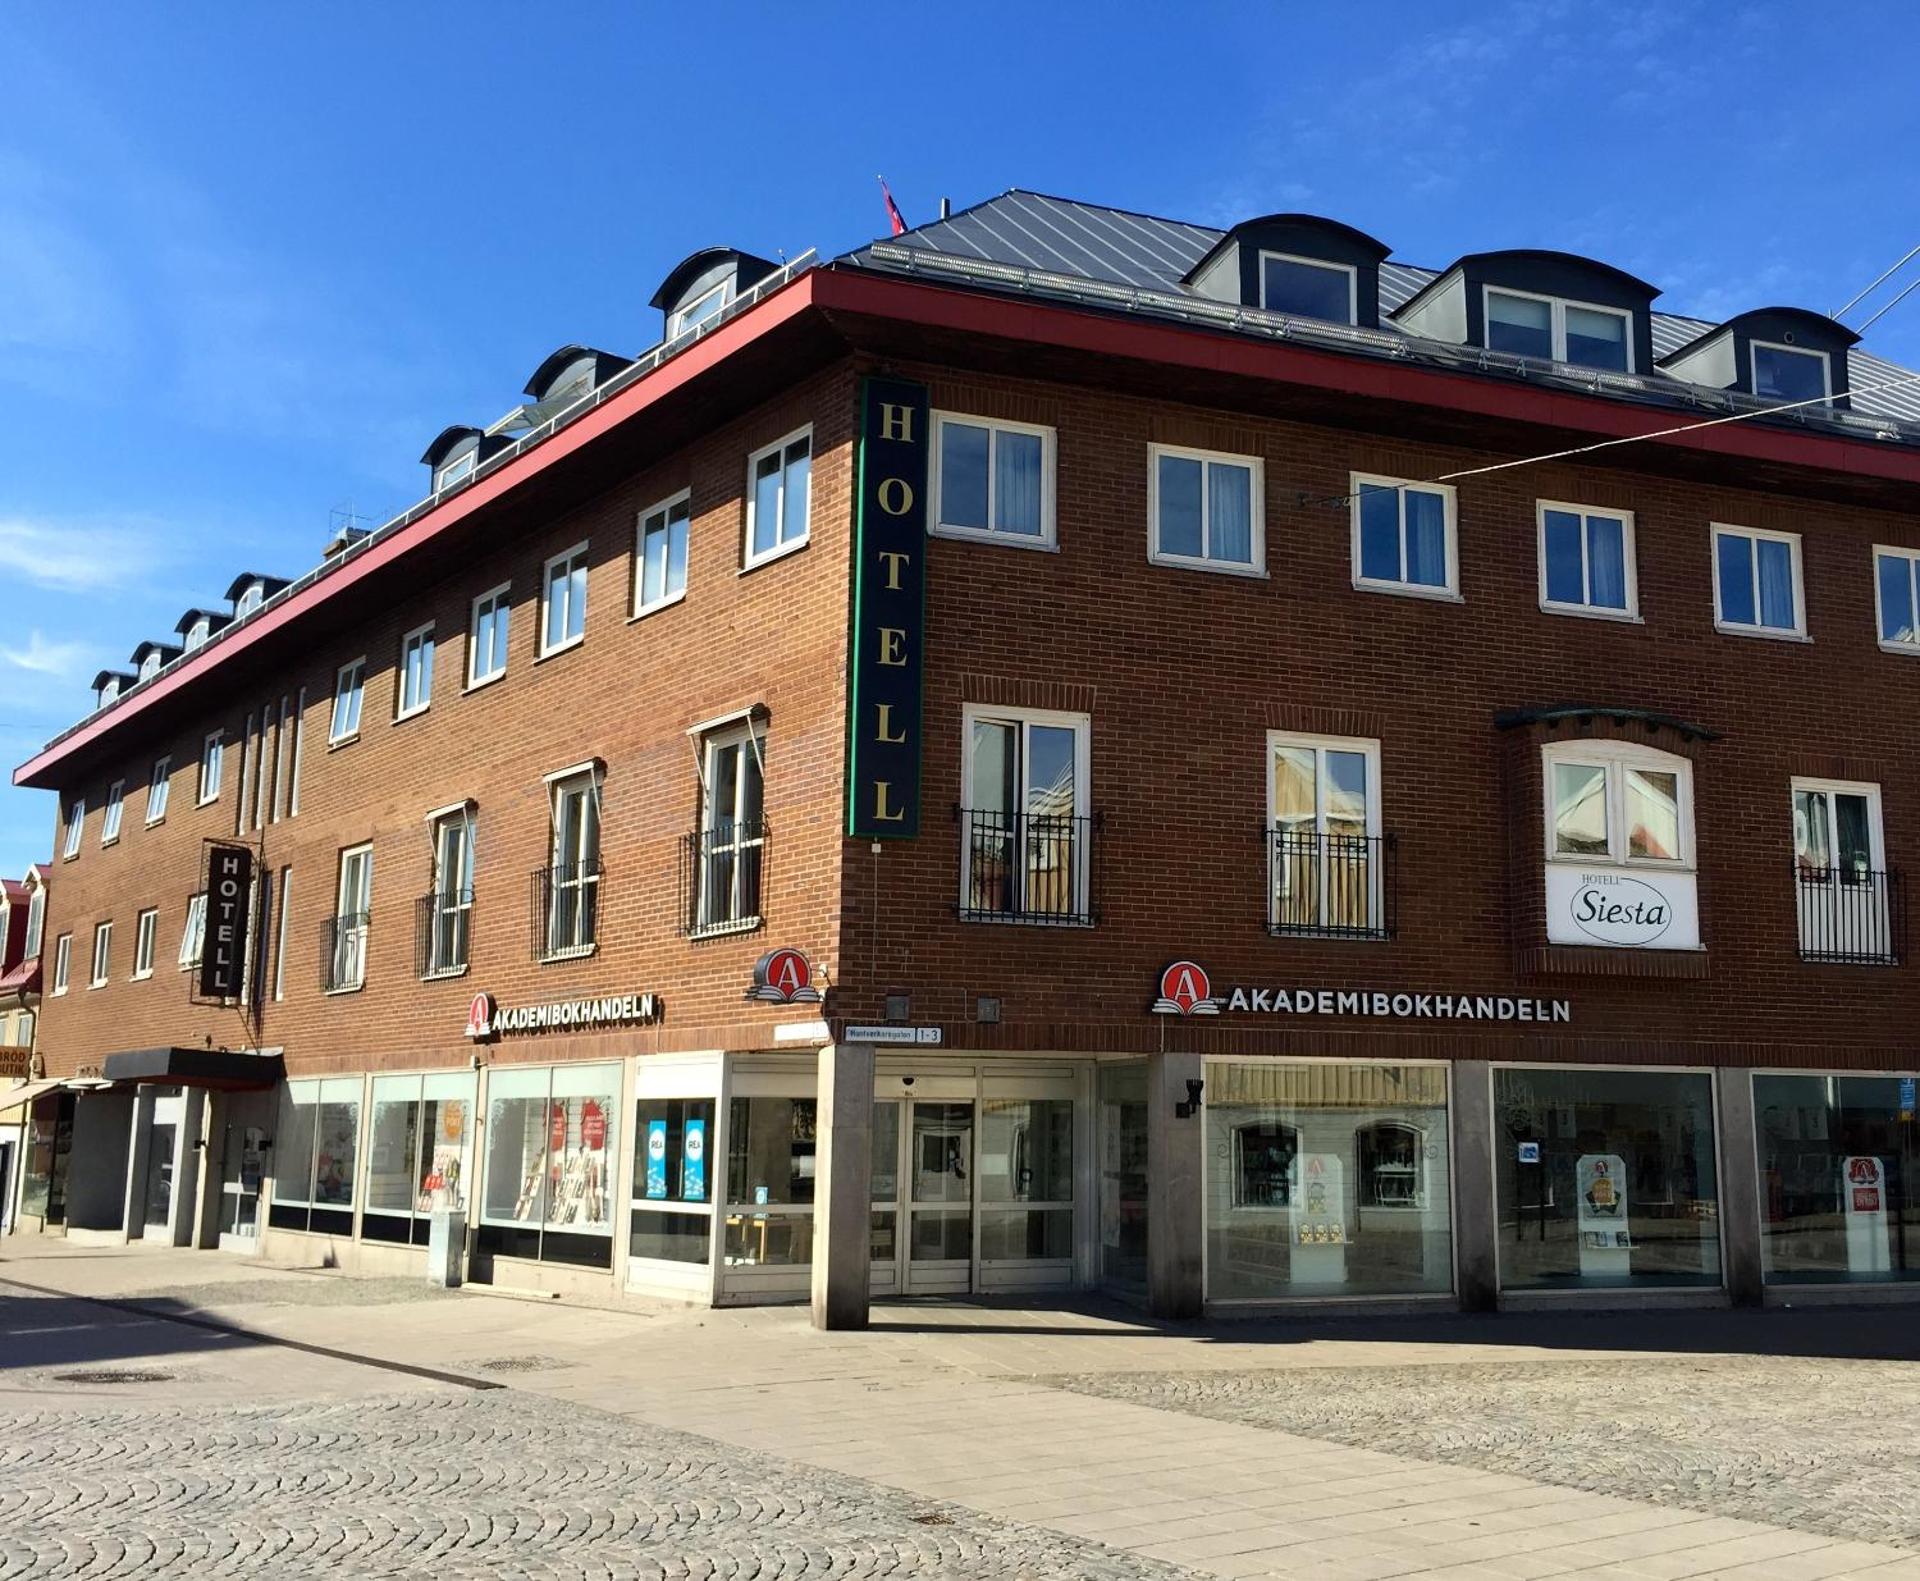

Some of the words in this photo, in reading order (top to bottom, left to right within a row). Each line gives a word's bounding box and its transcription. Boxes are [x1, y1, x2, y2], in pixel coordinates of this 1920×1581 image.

[872, 402, 915, 821] HOTELL
[1582, 874, 1620, 885] HOTELL
[214, 857, 239, 988] HOTELL
[1576, 890, 1667, 925] Siesta
[492, 993, 653, 1031] AKADEMIBOKHANDELN
[1228, 987, 1571, 1023] AKADEMIBOKHANDELN
